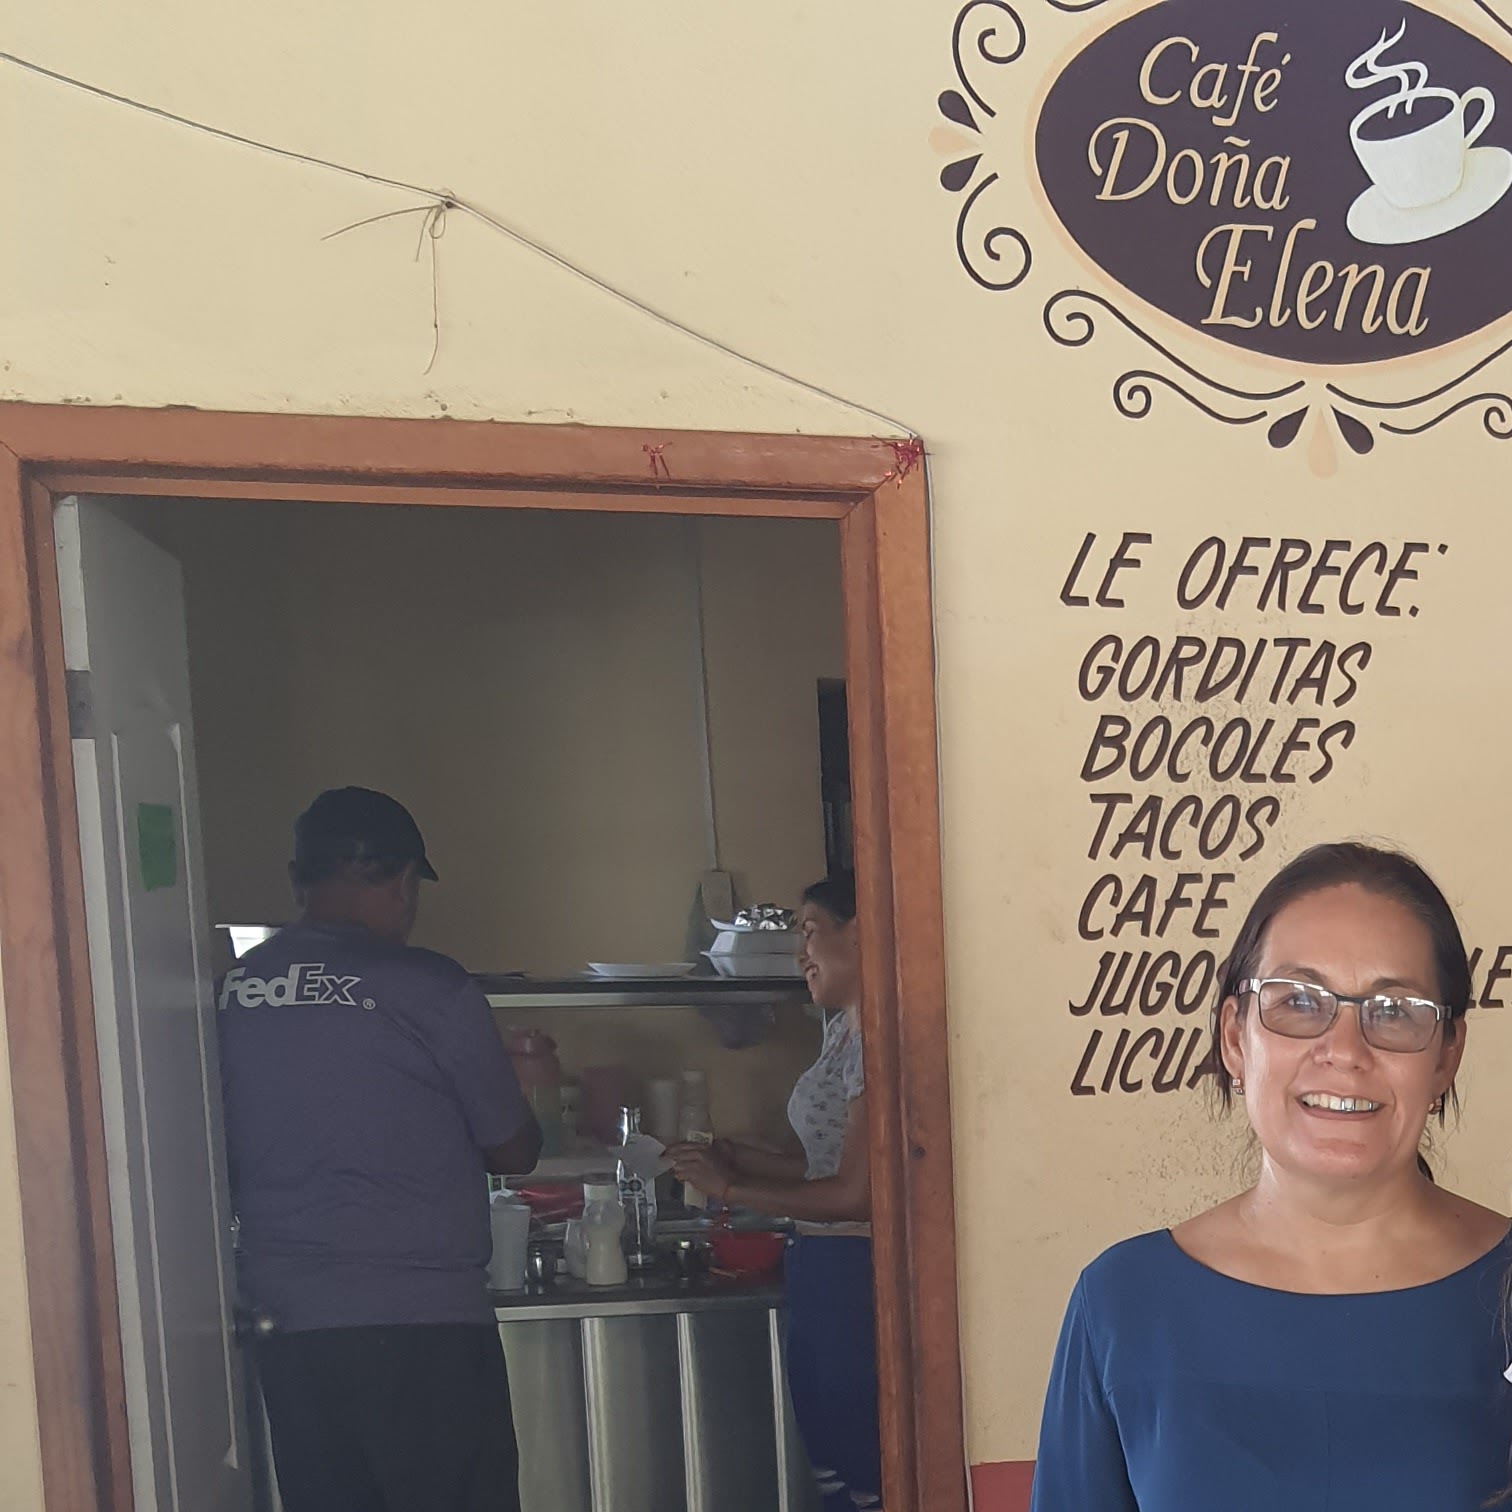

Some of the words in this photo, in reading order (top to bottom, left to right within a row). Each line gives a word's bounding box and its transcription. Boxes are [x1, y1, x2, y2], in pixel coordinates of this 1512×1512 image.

[1139, 32, 1292, 126] Café
[1088, 117, 1290, 210] Doña
[1196, 218, 1432, 336] Elena
[1060, 531, 1152, 608] LE
[1177, 535, 1449, 617] OFRECE:
[1078, 634, 1373, 708] GORDITAS
[1079, 714, 1356, 784] BOCOLES
[1087, 792, 1281, 862] TACOS
[1077, 872, 1236, 942] CAFE
[218, 962, 362, 1011] FedEx
[1068, 949, 1230, 1017] JUGO
